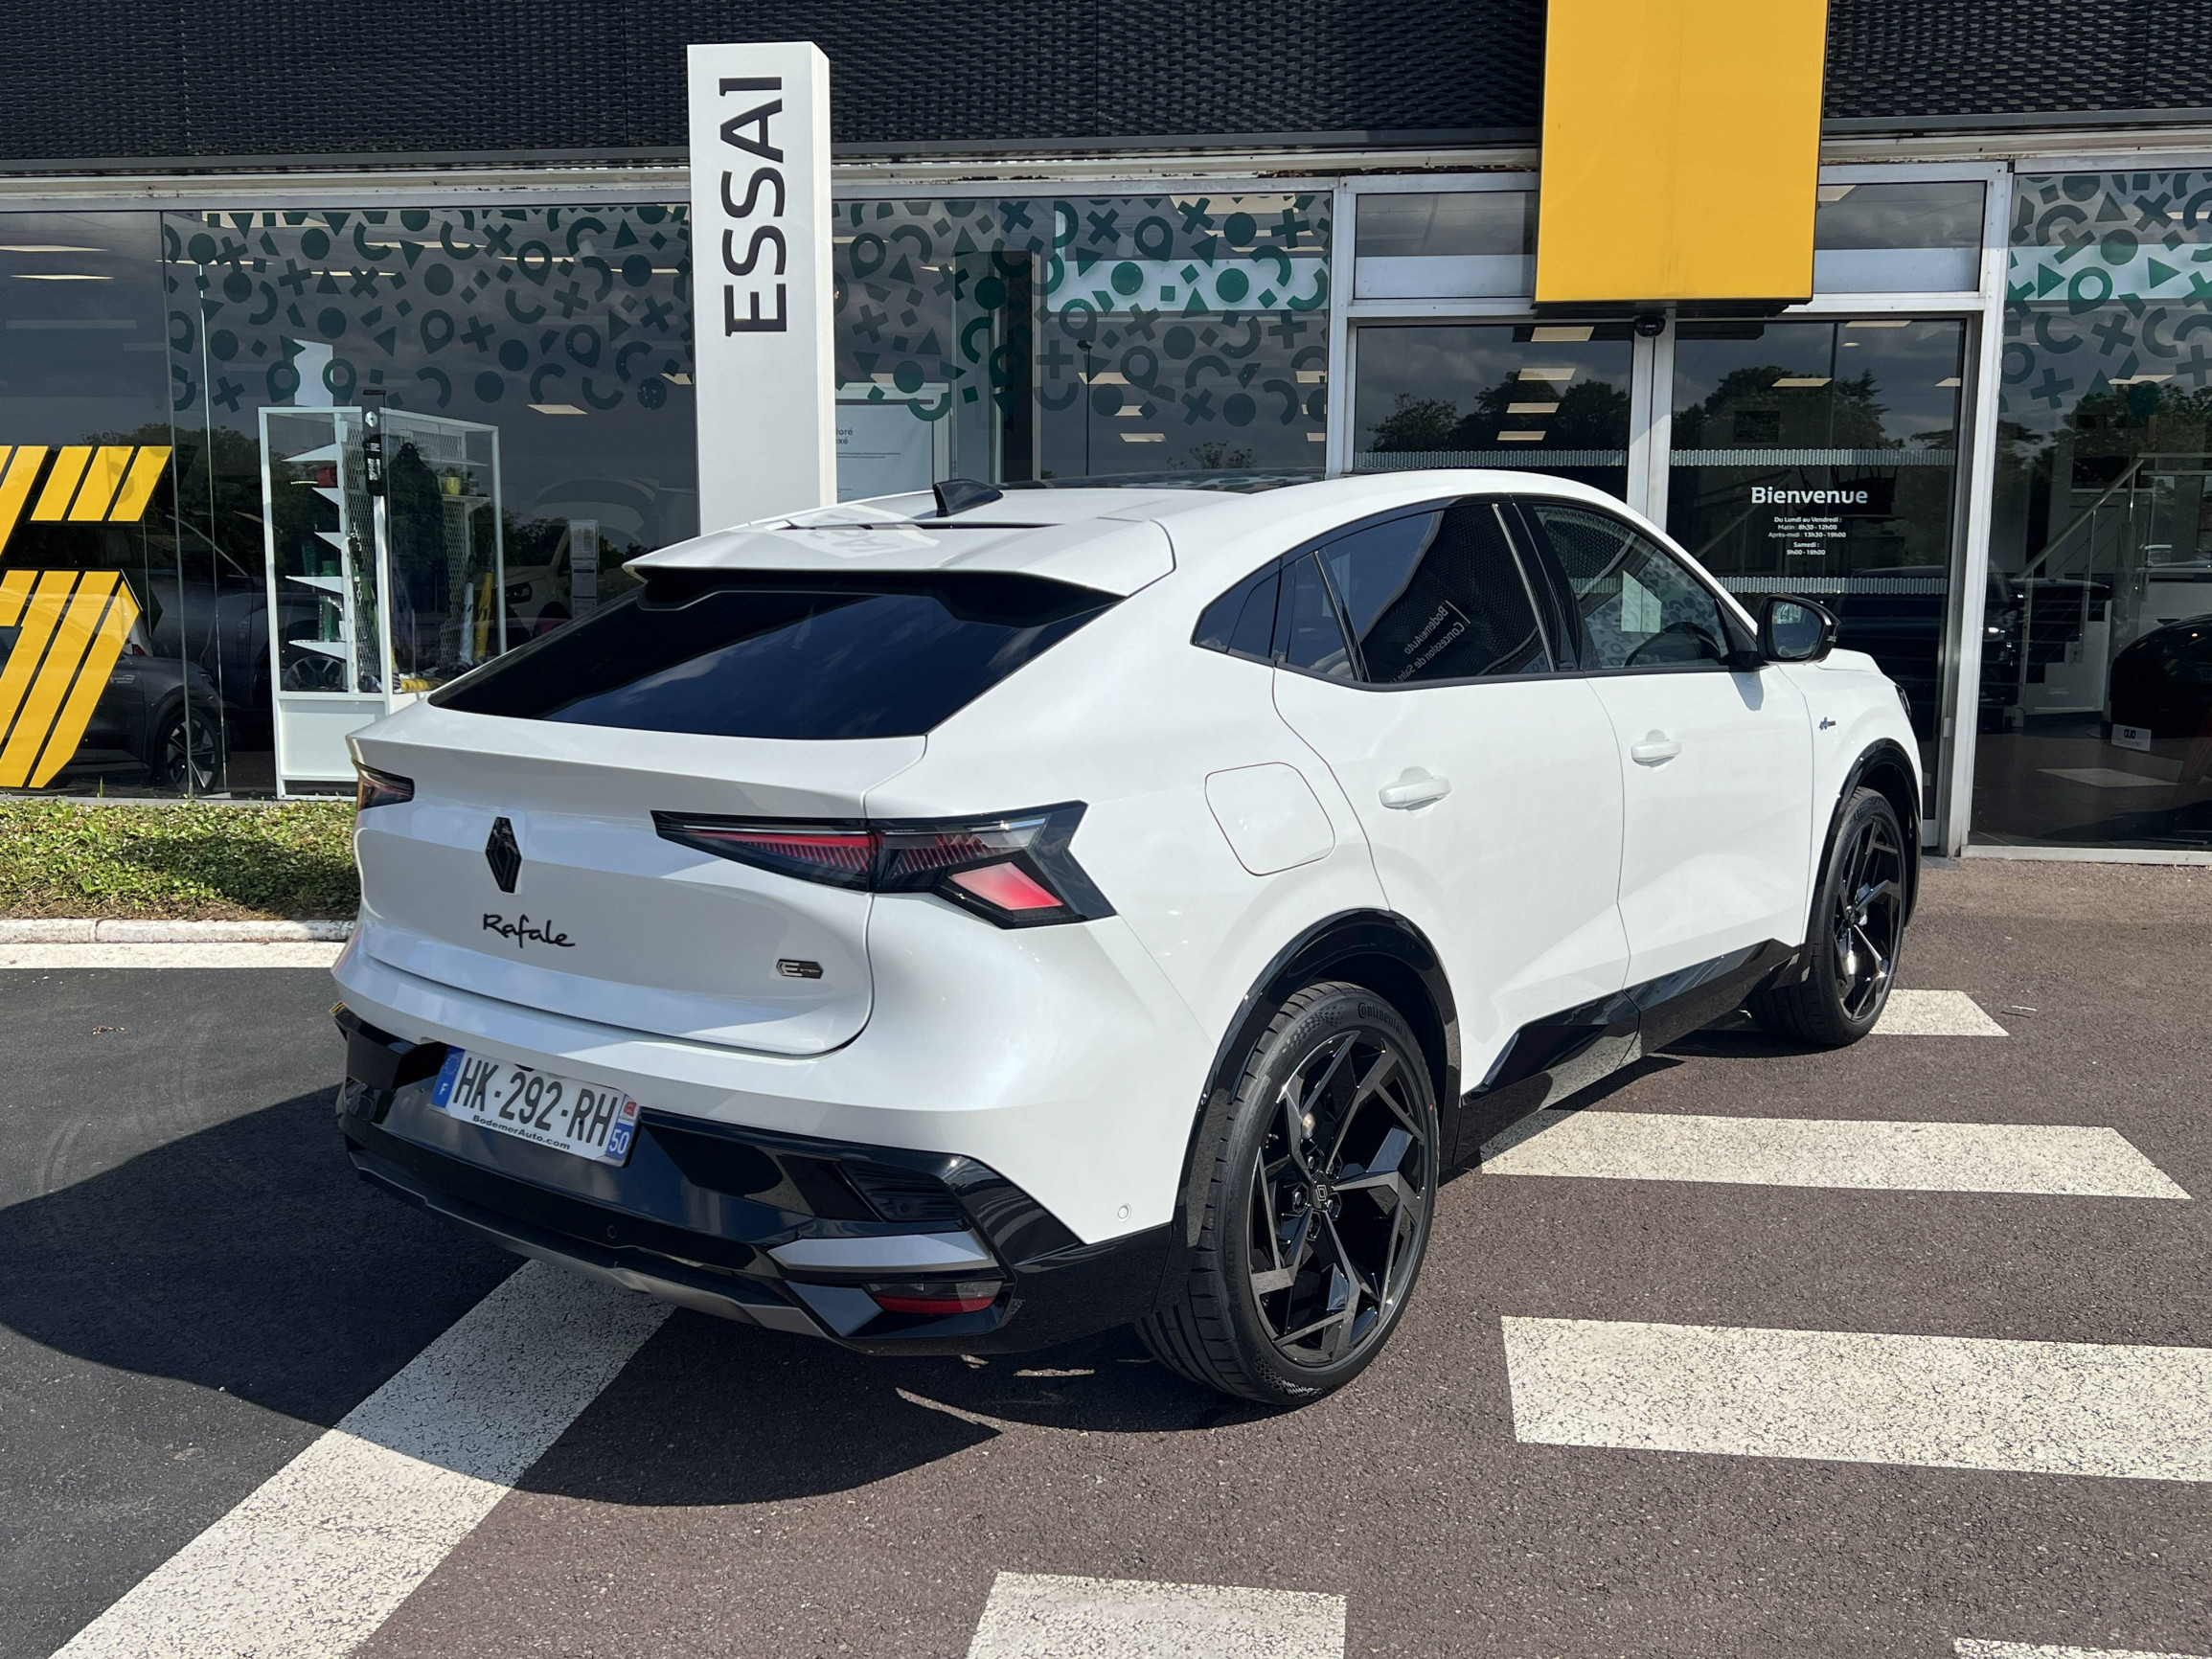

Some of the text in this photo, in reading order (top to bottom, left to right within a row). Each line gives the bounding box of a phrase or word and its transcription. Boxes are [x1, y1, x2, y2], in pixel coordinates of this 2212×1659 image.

[719, 77, 787, 337] ESSAI
[836, 427, 854, 436] loré
[1751, 487, 1868, 504] Bienvenue
[482, 913, 575, 948] Rafale
[1357, 1002, 1402, 1035] Continental
[439, 1082, 448, 1096] F
[452, 1057, 619, 1148] HK-292-RH
[472, 1115, 571, 1150] BodemerAuto.com
[608, 1127, 630, 1154] 50
